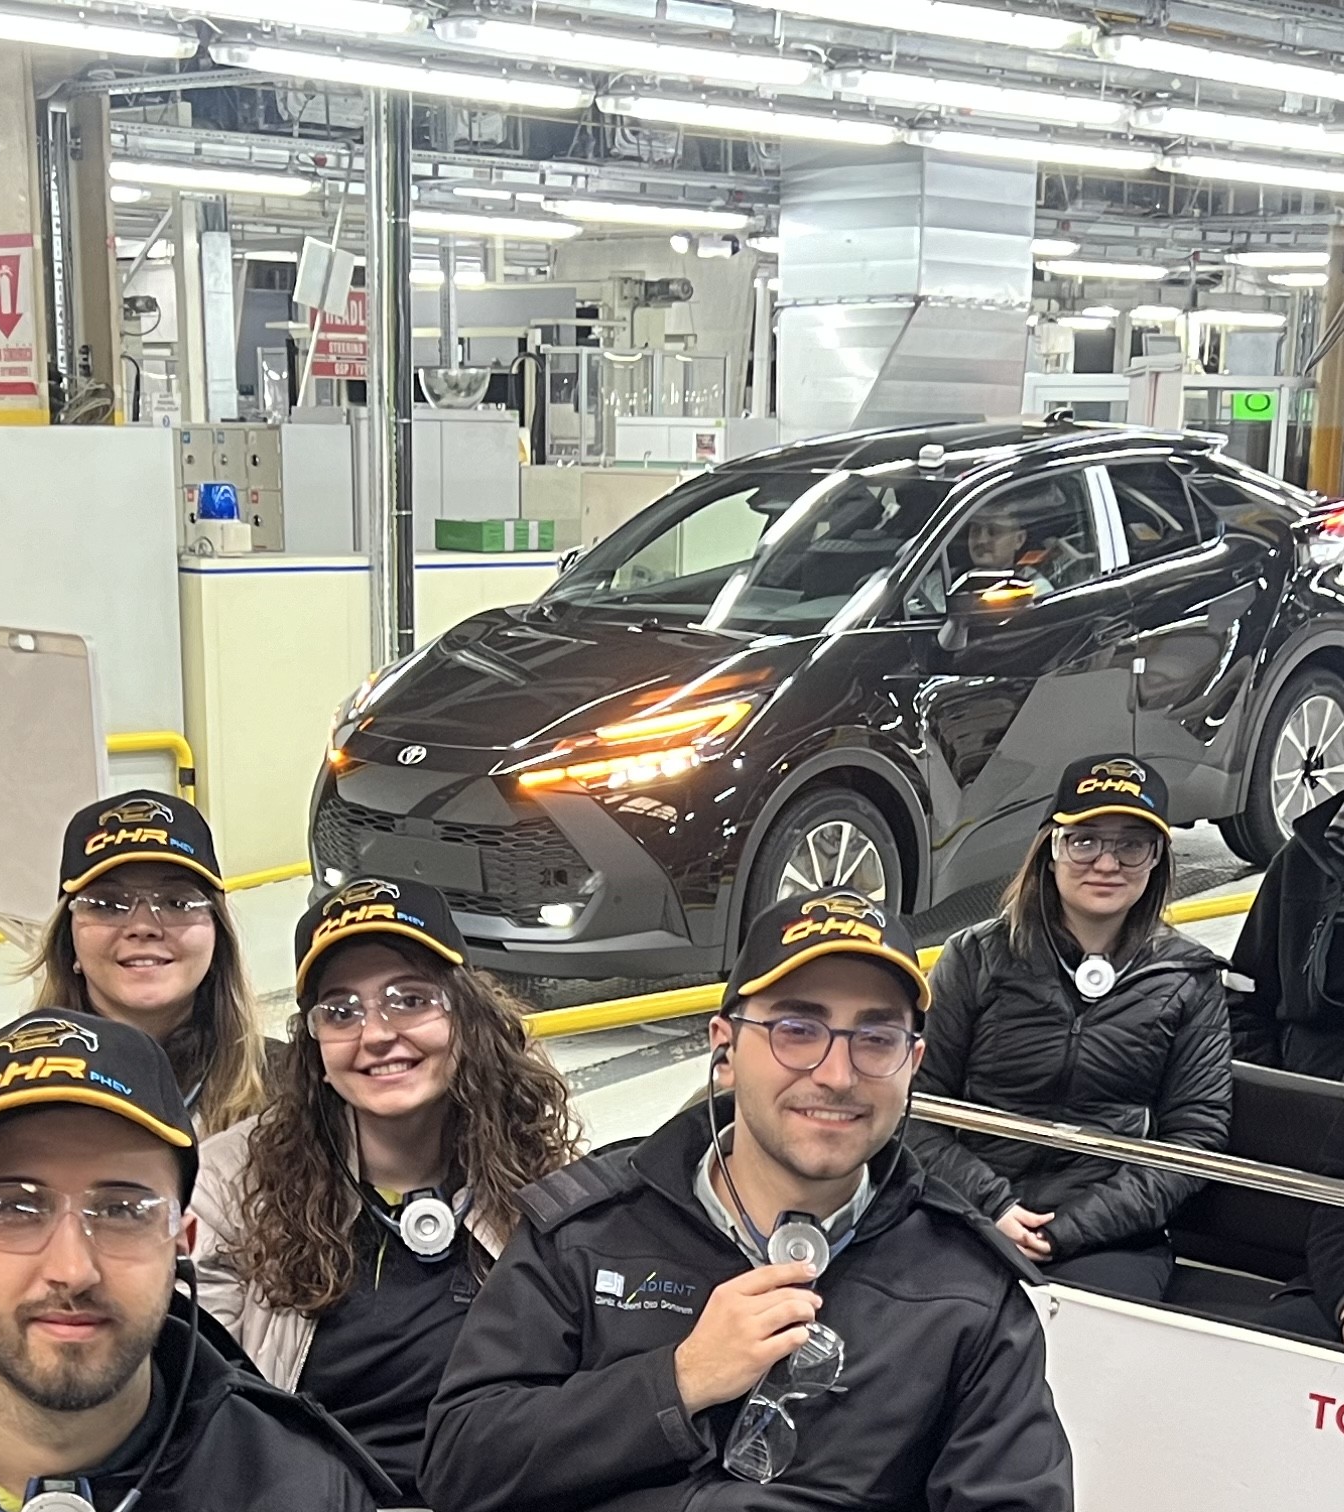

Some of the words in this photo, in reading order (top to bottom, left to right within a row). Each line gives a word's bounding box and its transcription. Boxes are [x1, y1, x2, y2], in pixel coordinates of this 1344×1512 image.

[84, 828, 168, 856] C-HR
[782, 917, 882, 944] C-HR
[89, 1070, 133, 1096] PHEV
